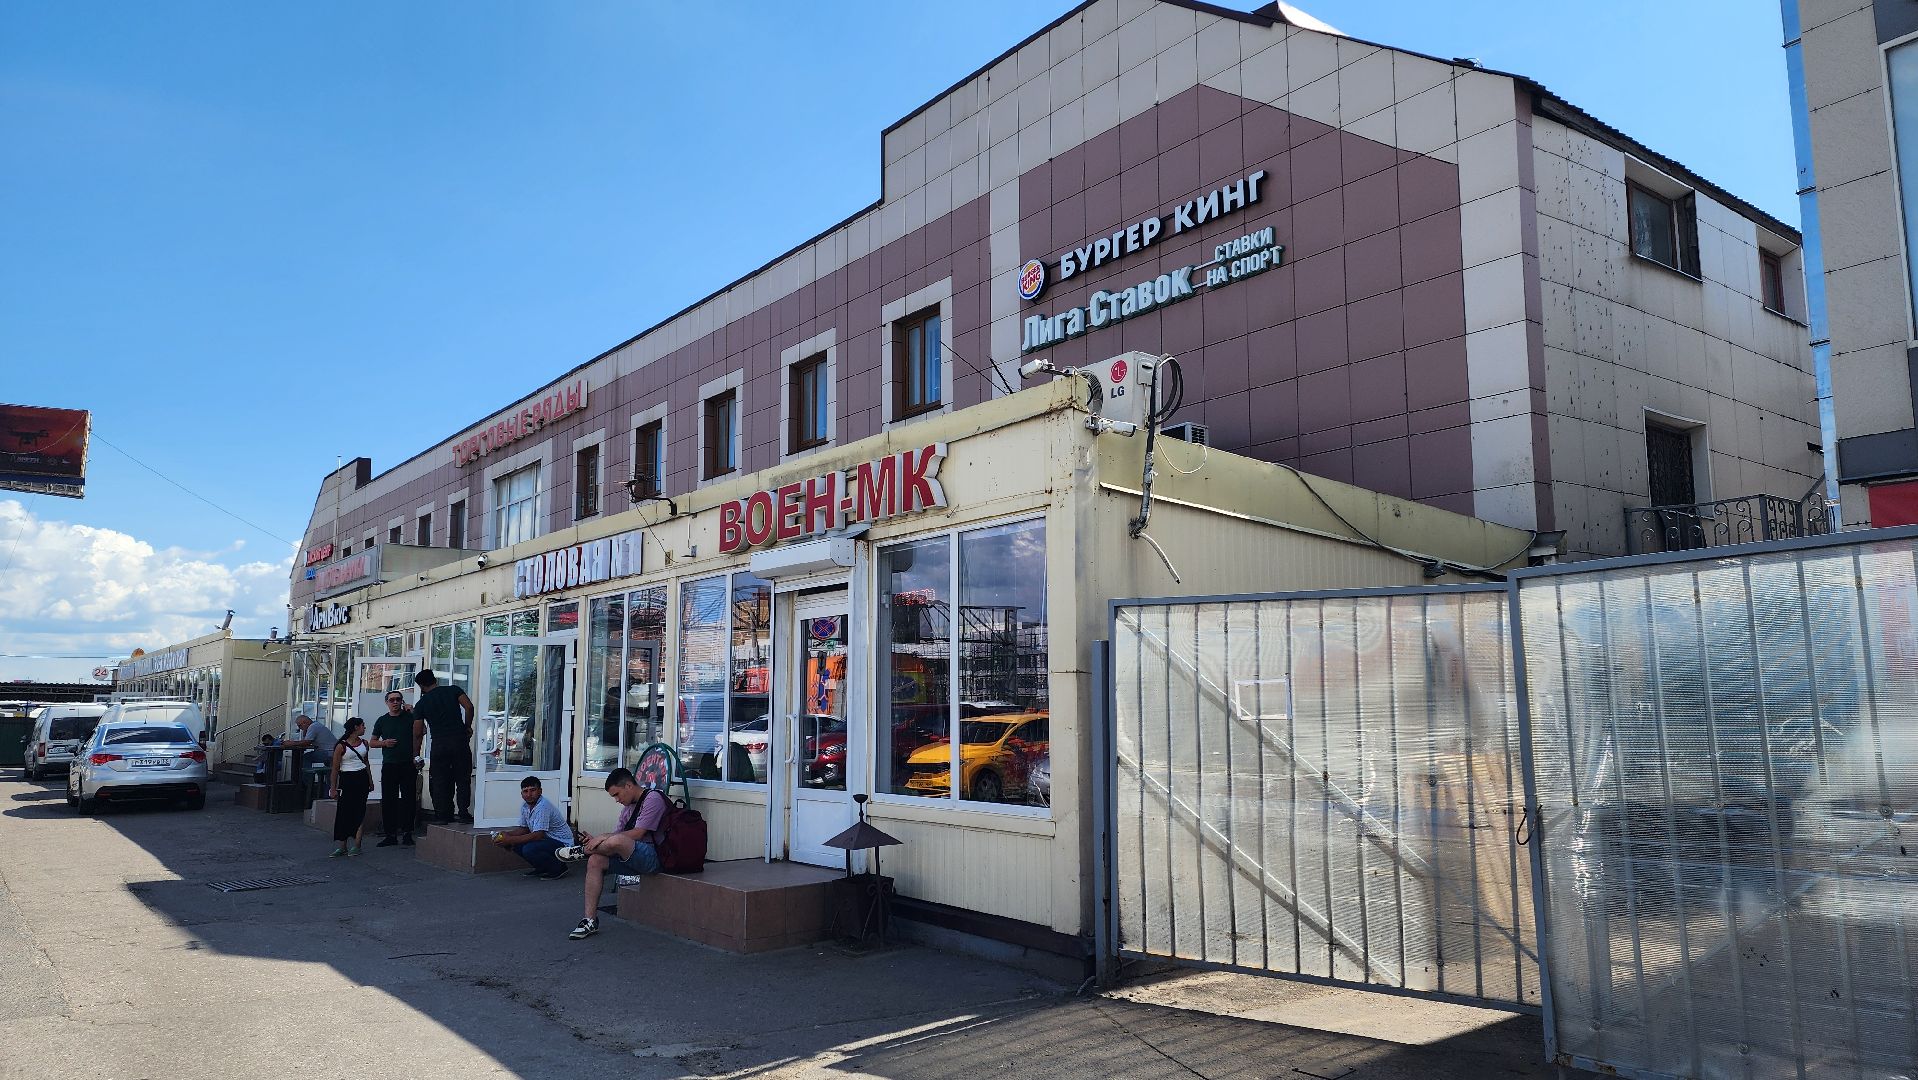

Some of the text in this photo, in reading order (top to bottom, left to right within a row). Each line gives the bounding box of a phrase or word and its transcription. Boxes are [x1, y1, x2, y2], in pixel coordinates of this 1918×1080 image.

[1060, 169, 1266, 280] БУРГЕР КИНГ
[1214, 227, 1274, 263] СТАВКИ
[1022, 271, 1041, 294] KING
[1206, 245, 1283, 288] НА СПОРТ
[1021, 266, 1194, 352] Лига Ставок
[1110, 385, 1125, 399] LG
[452, 380, 584, 467] ТОРГОВЫЕ РЯДЫ
[719, 442, 942, 554] ВОЕН-МК
[514, 539, 606, 599] СТОЛОВАЯ
[94, 668, 108, 677] 24
